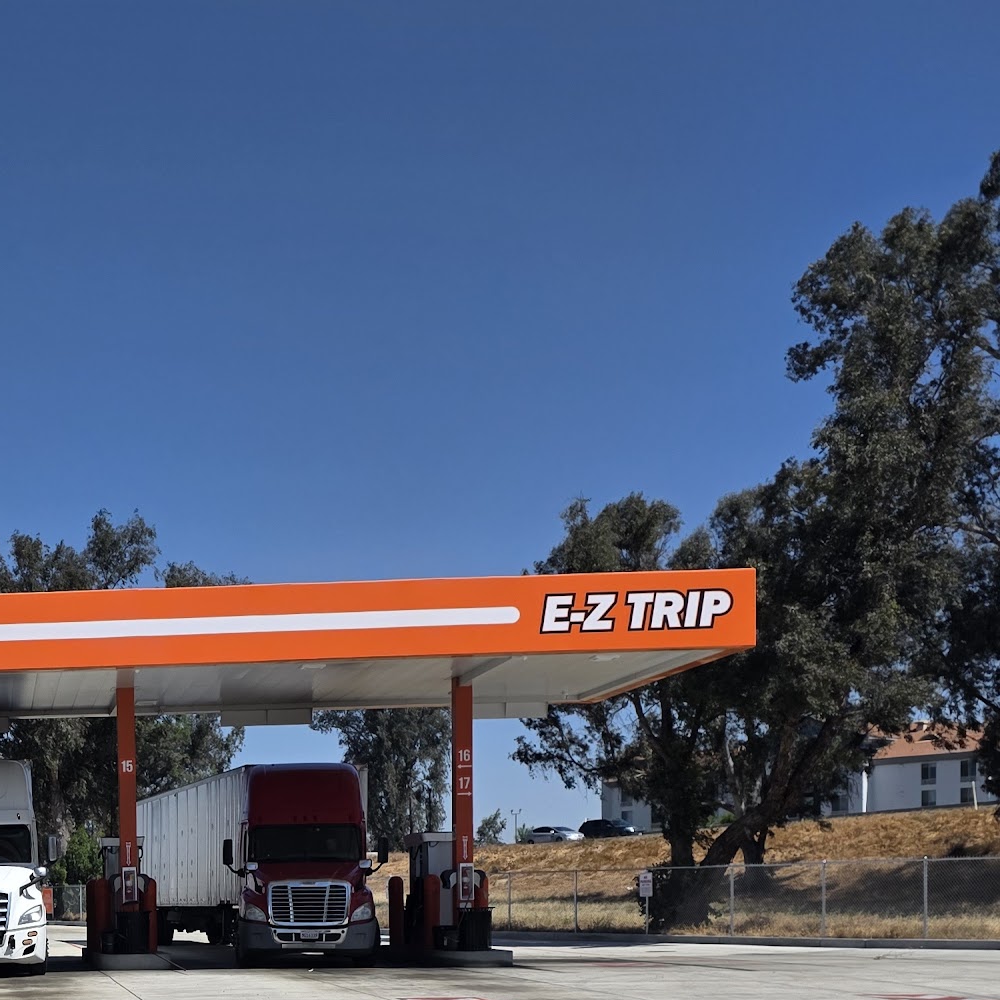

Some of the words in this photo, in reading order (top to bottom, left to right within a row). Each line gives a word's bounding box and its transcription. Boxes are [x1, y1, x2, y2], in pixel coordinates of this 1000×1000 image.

[540, 592, 618, 633] E-Z
[625, 588, 733, 631] TRIP
[458, 749, 470, 761] 16
[121, 760, 133, 772] 15
[459, 777, 470, 789] 17
